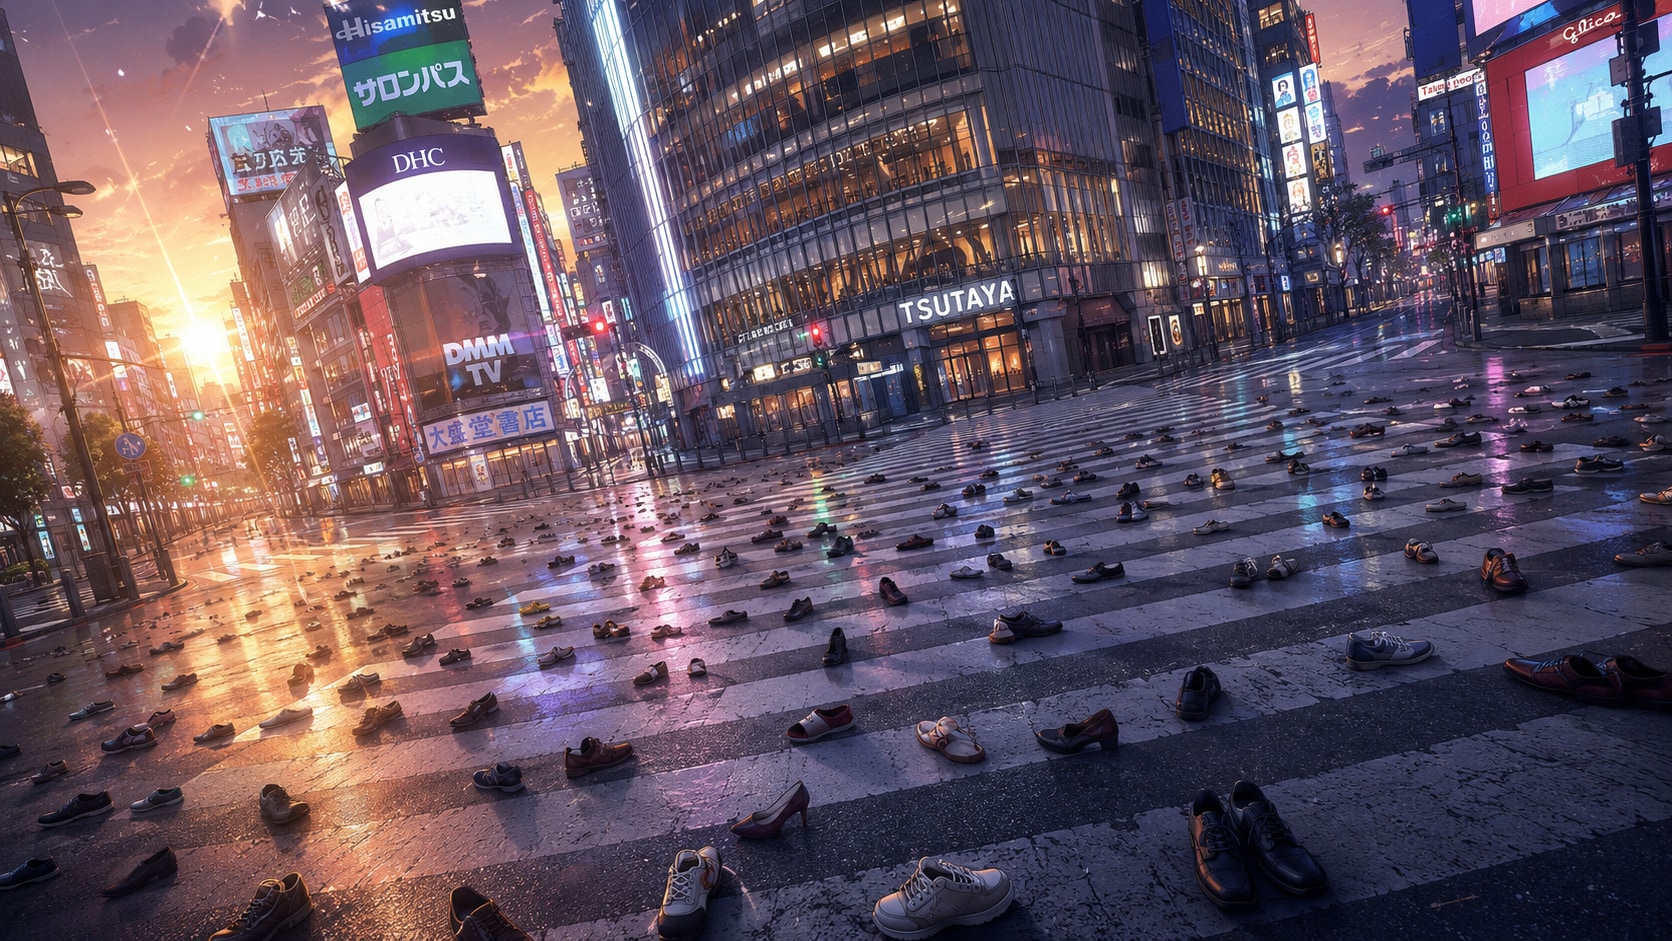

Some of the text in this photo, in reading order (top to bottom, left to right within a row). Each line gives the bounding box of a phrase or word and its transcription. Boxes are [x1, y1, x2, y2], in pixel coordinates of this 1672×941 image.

[335, 7, 456, 42] Hisamitsu
[353, 60, 471, 108] サロンパス
[391, 147, 446, 175] DHC
[898, 279, 1016, 324] TSUTAYA
[442, 333, 516, 367] DMM
[465, 359, 502, 387] TV
[427, 405, 546, 451] 大盛堂書店
